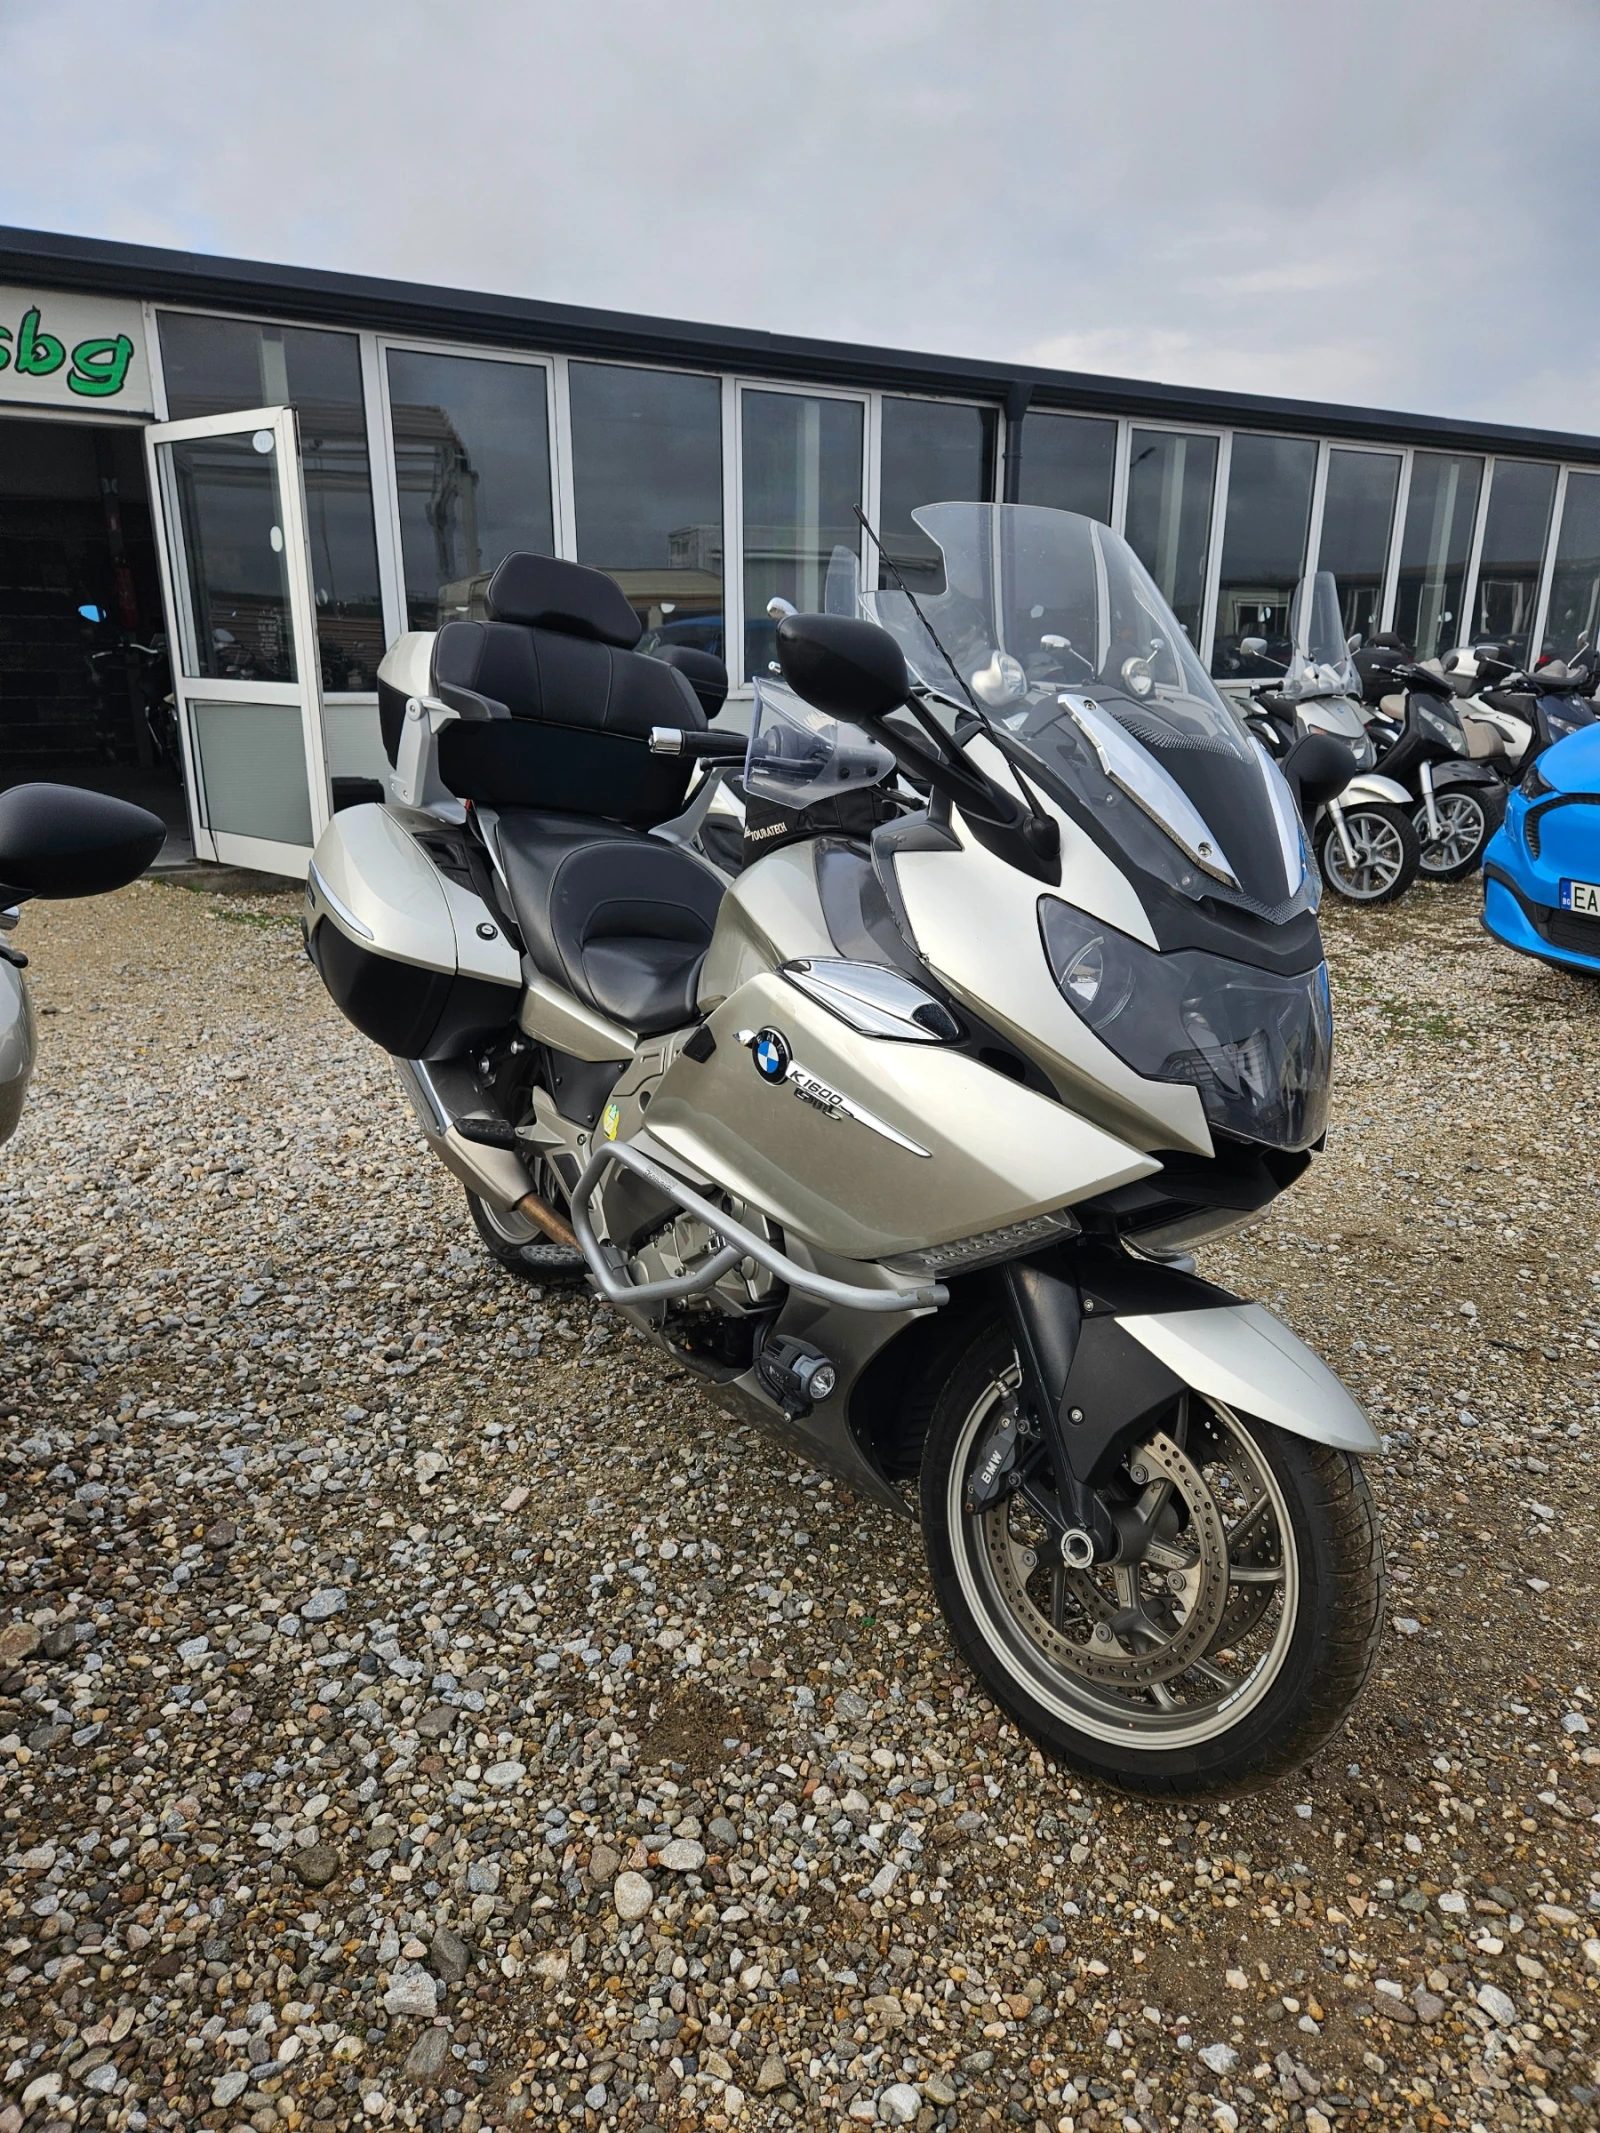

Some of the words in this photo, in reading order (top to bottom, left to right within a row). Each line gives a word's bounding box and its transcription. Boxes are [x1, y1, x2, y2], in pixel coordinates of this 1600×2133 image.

[750, 822, 788, 842] TOURATECH
[1562, 897, 1571, 906] BG
[1574, 886, 1599, 913] EA
[789, 1070, 806, 1083] K
[803, 1079, 844, 1106] 1600
[980, 1450, 1003, 1485] BMW
